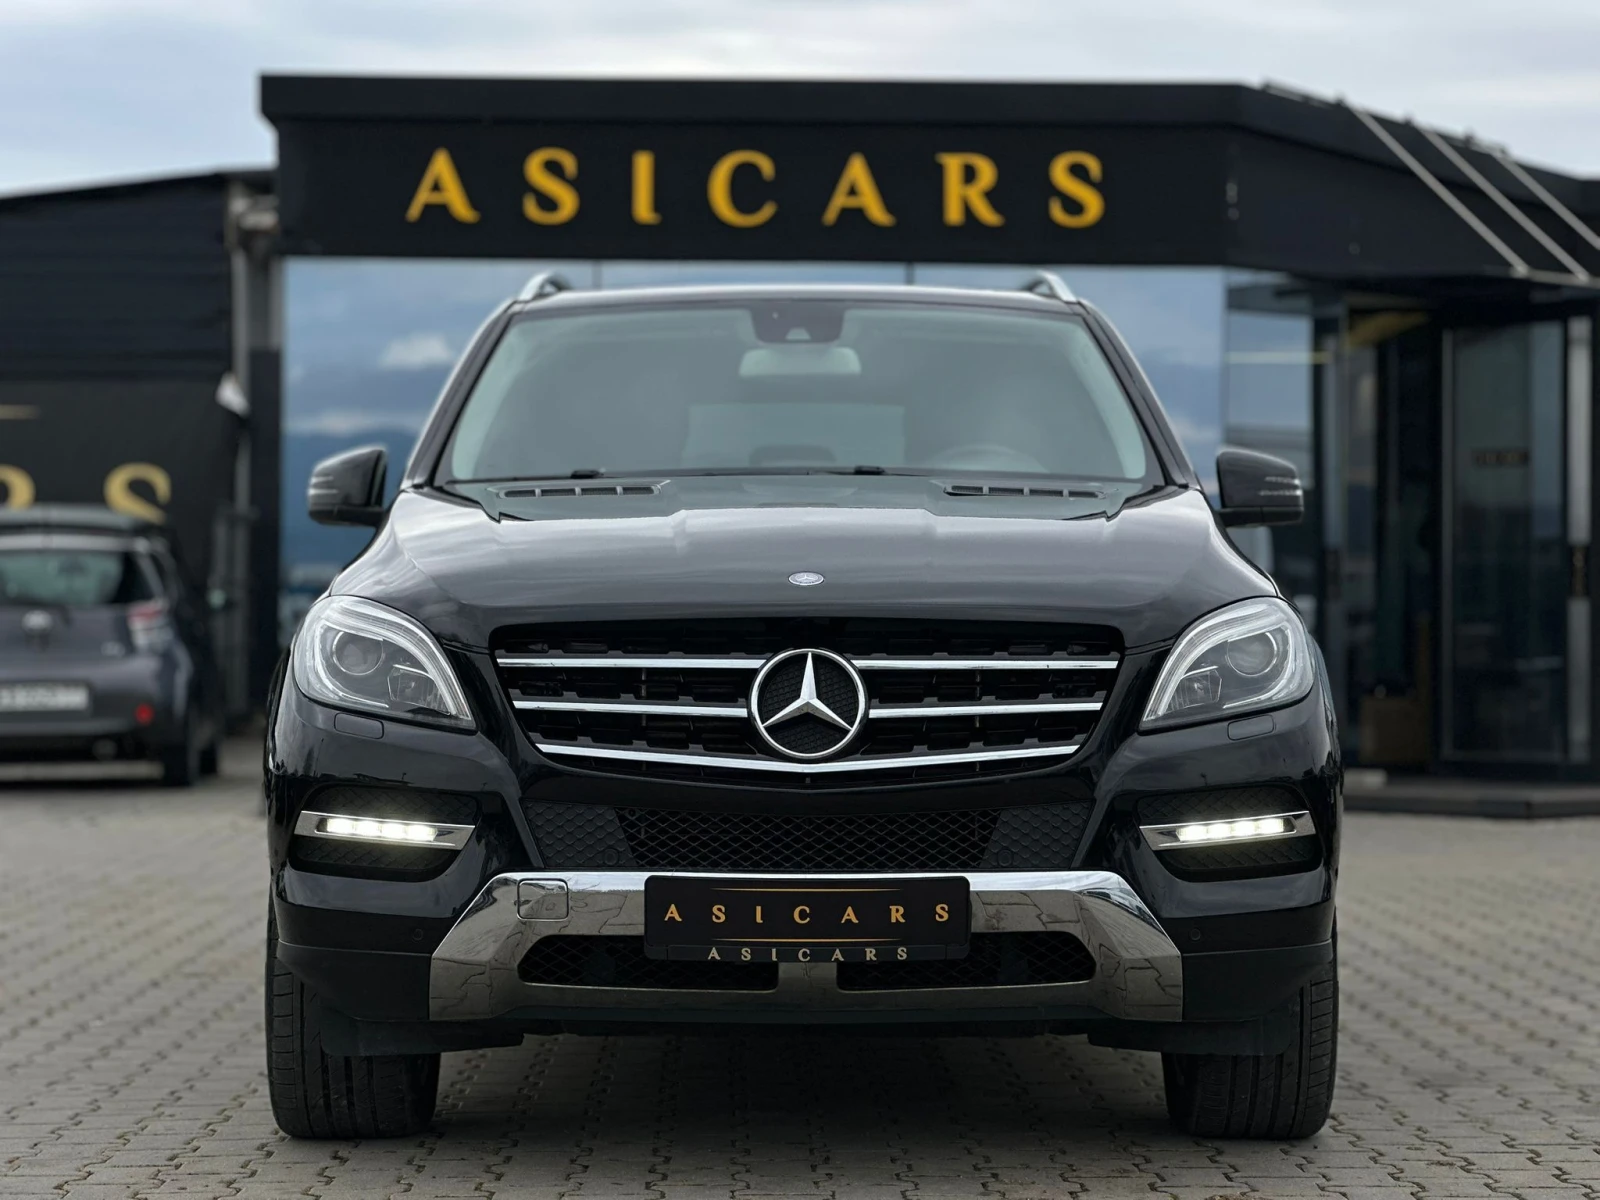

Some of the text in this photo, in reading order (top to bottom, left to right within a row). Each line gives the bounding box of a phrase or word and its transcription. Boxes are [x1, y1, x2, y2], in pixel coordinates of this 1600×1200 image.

[405, 147, 1105, 228] ASICARS
[664, 903, 949, 923] ASICARS
[707, 947, 908, 962] ASICARS
